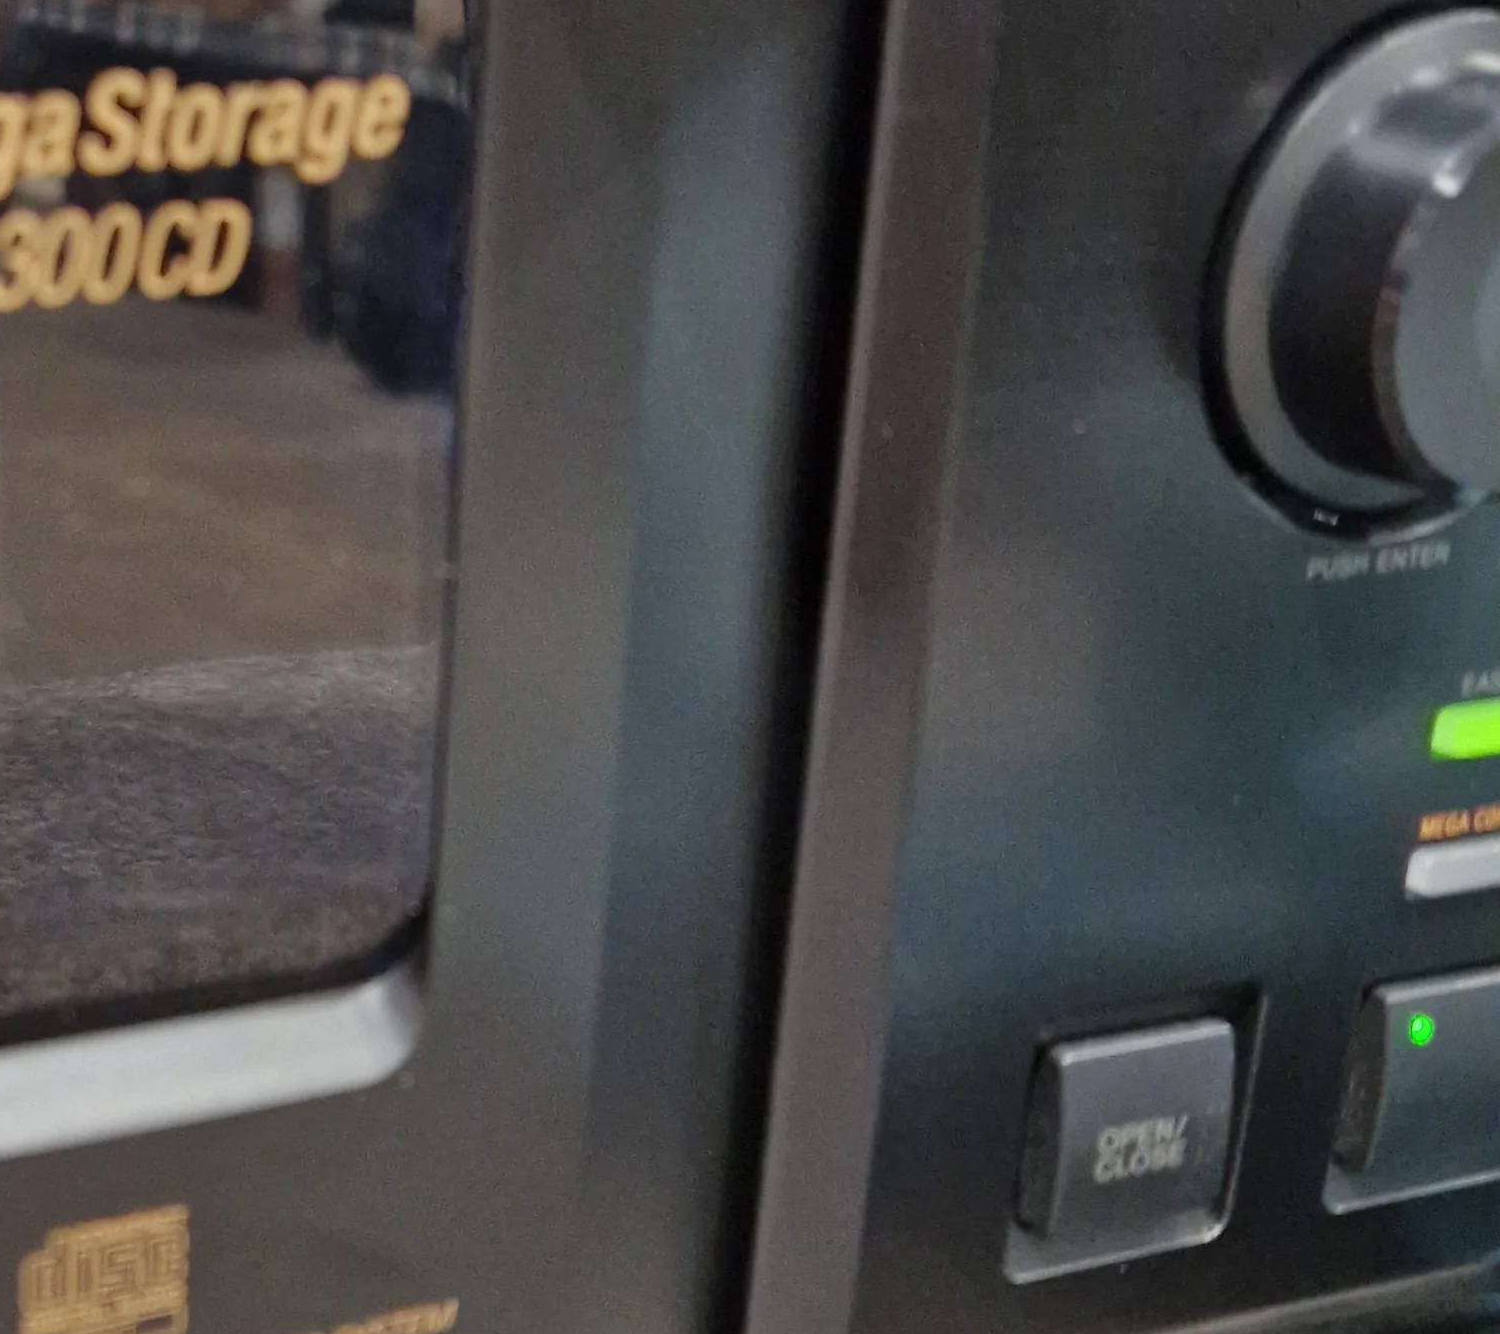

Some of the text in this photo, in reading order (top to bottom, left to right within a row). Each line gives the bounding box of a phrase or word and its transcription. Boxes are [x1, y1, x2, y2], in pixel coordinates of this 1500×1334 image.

[1306, 543, 1450, 581] PUSH ENTER
[1419, 809, 1469, 841] MEGA
